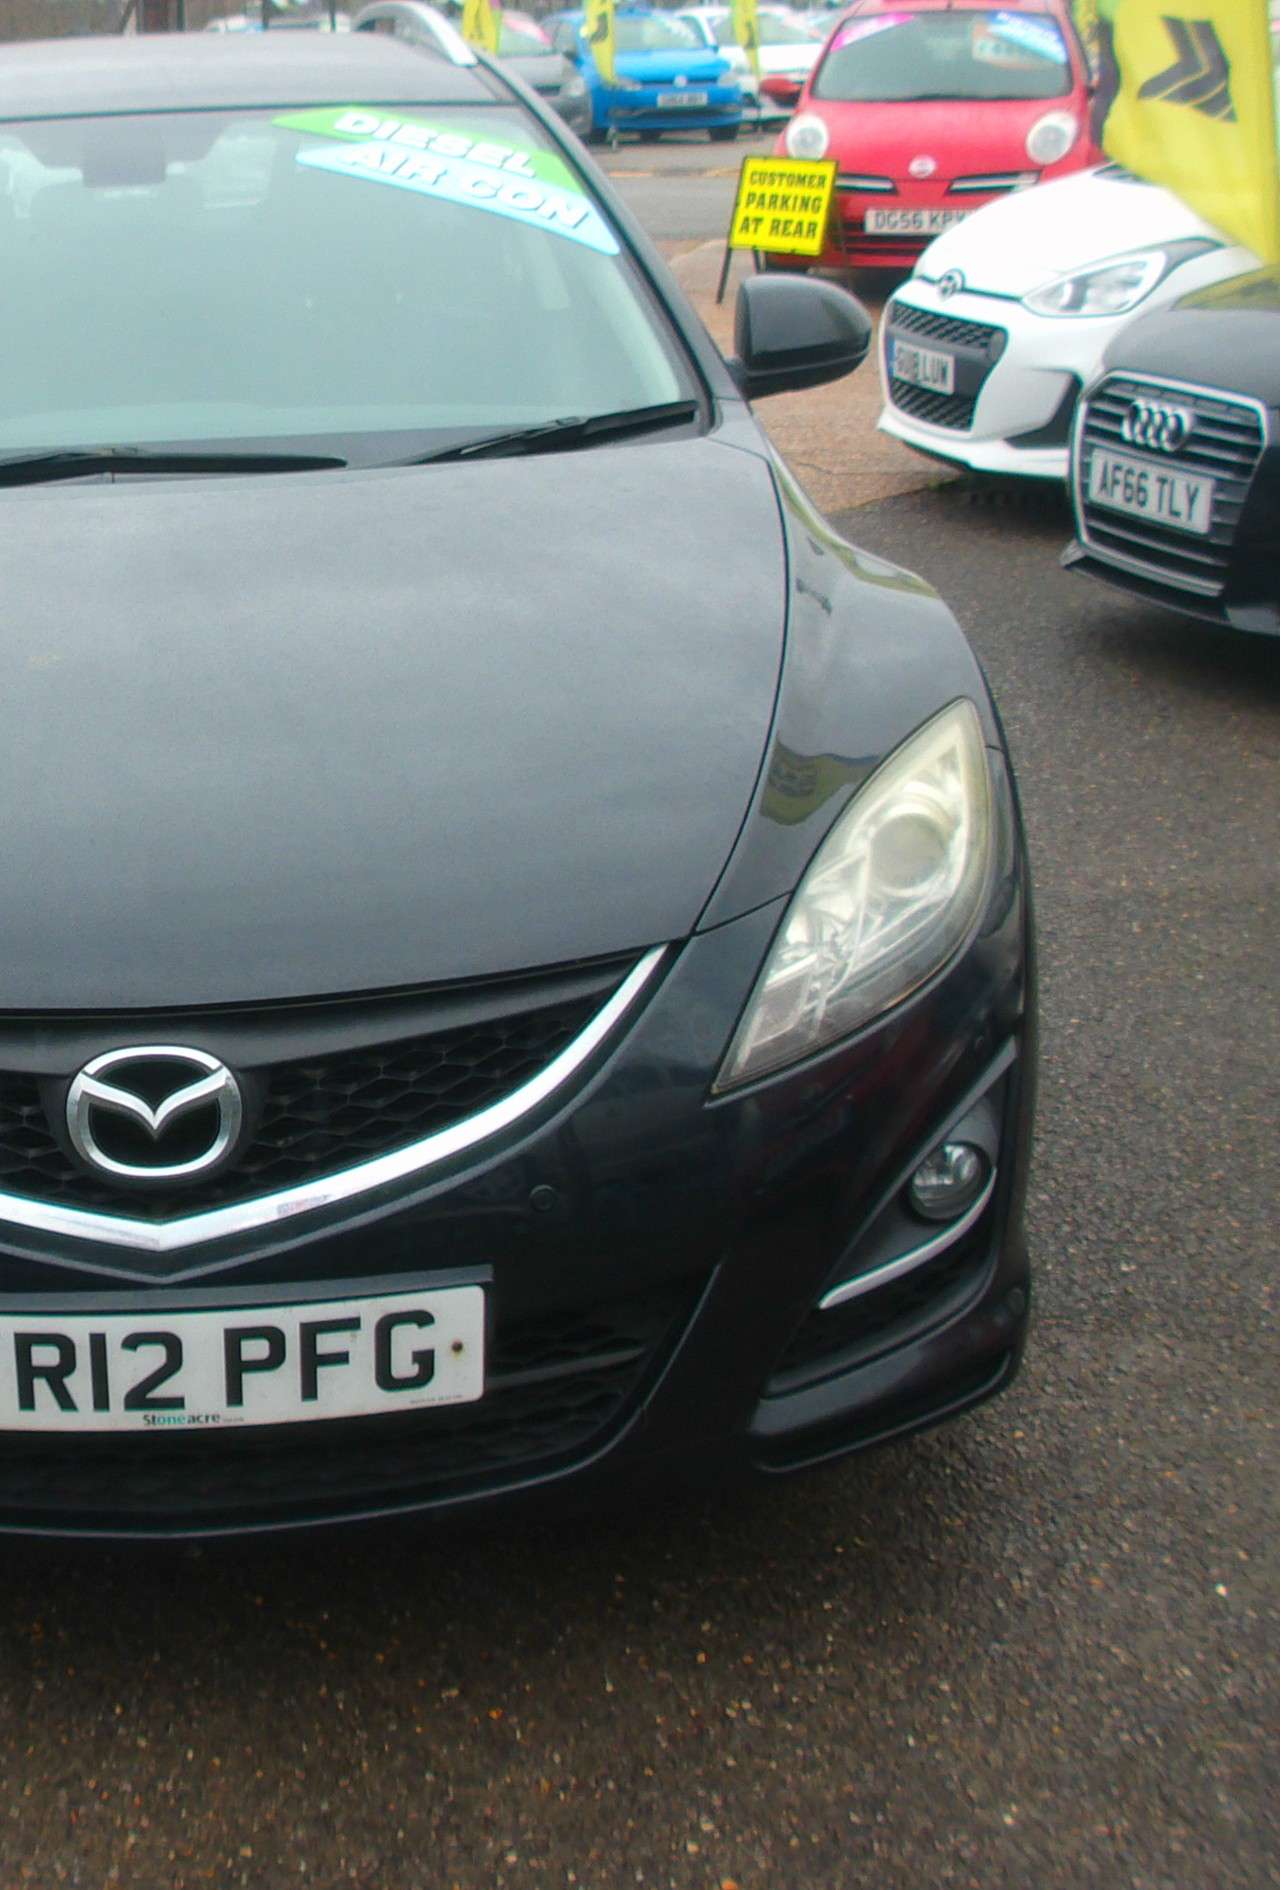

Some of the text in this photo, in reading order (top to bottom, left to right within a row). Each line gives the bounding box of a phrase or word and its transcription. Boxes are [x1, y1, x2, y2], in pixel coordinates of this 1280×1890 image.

[333, 111, 537, 179] DIESEL
[337, 147, 590, 230] AIR CON
[745, 192, 823, 214] PARKING
[749, 170, 827, 188] CUSTOMER
[739, 216, 818, 240] AT REAR
[1097, 459, 1200, 522] AF66 TLY
[223, 1308, 437, 1408] PFG
